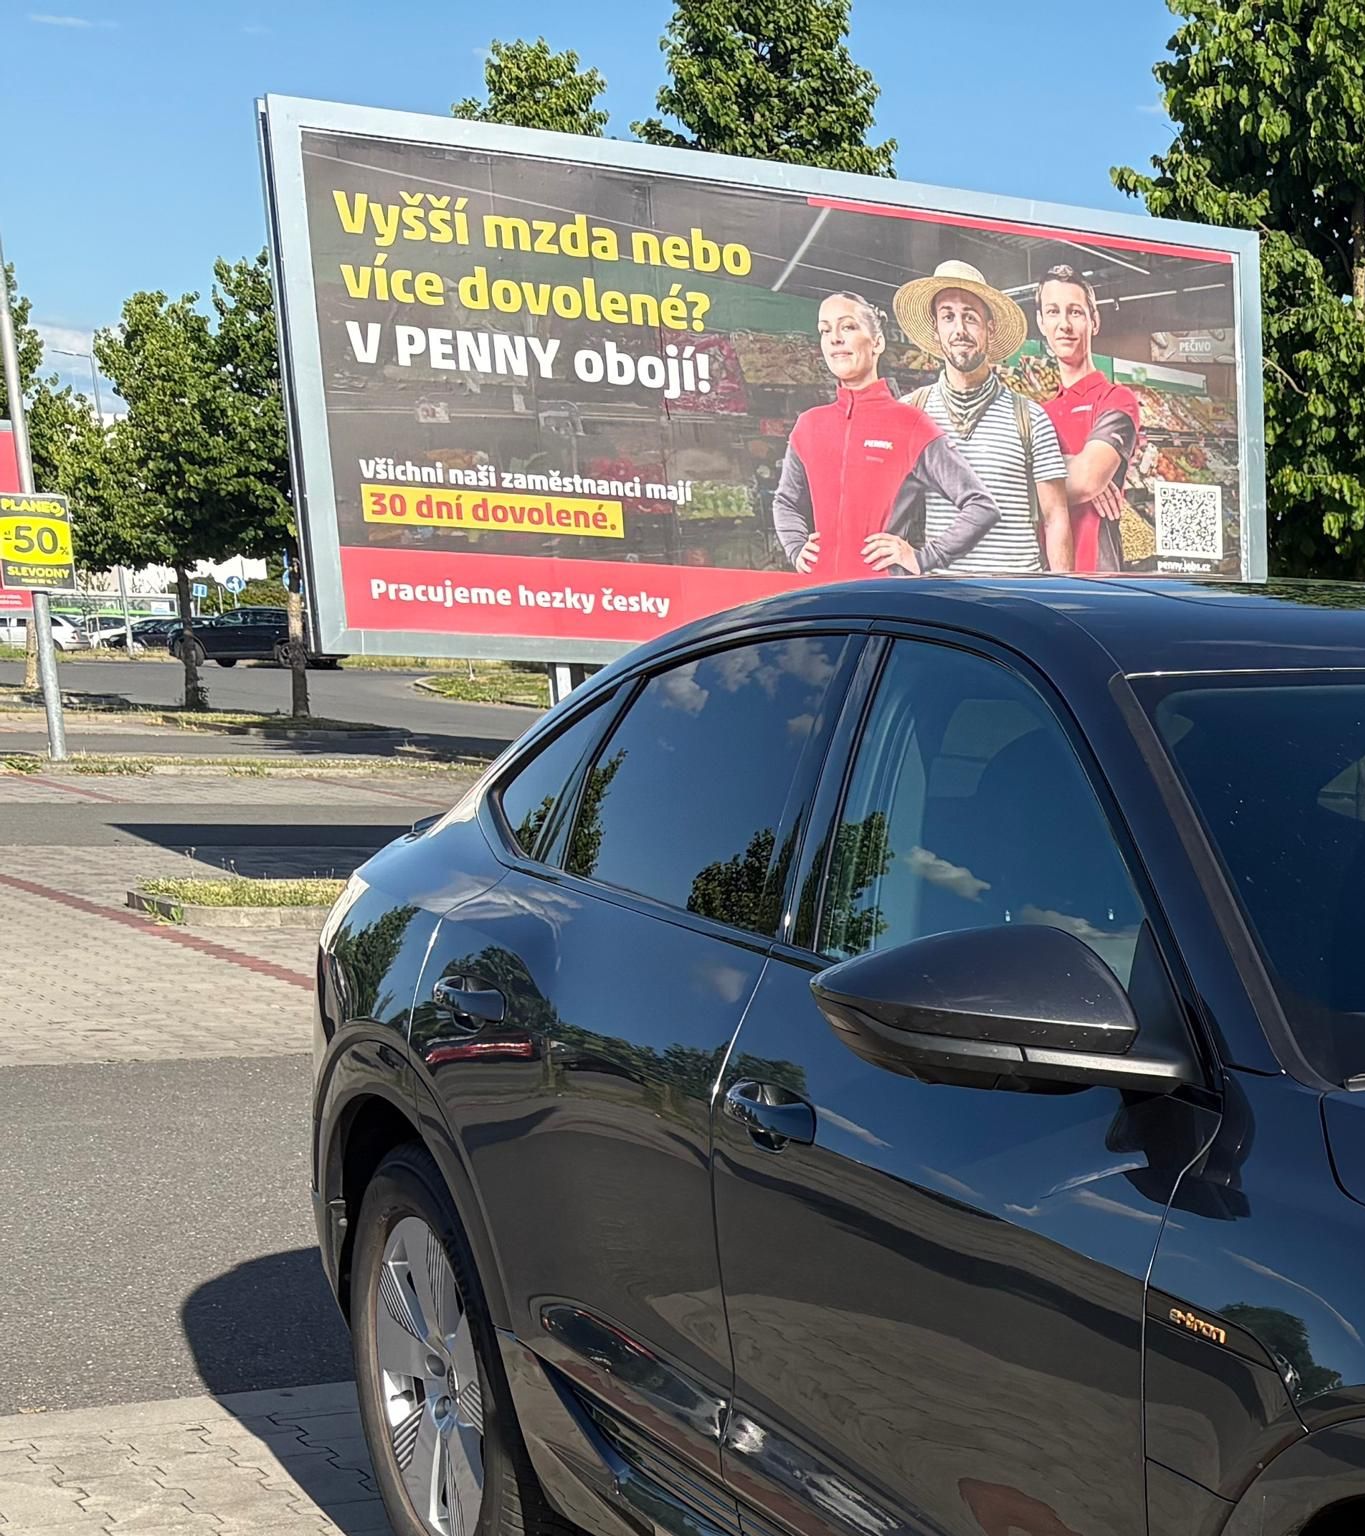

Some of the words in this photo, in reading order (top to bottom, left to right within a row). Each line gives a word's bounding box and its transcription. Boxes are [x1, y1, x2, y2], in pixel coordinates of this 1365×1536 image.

[333, 190, 468, 247] Vyšší
[484, 213, 618, 262] mzda
[632, 228, 752, 276] nebo
[341, 252, 444, 306] více
[459, 266, 710, 332] dovolené?
[346, 320, 381, 365] V
[396, 325, 560, 379] PENNY
[574, 341, 711, 399] obojí!
[1179, 339, 1212, 353] PEČIVO
[359, 458, 444, 485] Všichni
[449, 465, 496, 489] naši
[501, 470, 641, 499] zaměstnanci
[646, 480, 692, 505] mají
[370, 493, 406, 516] 30
[416, 495, 463, 520] dní
[472, 498, 616, 531] dovolené.
[7, 566, 70, 578] SLEVODNY
[370, 579, 512, 608] Pracujeme
[519, 585, 596, 614] hezky
[602, 587, 671, 618] česky
